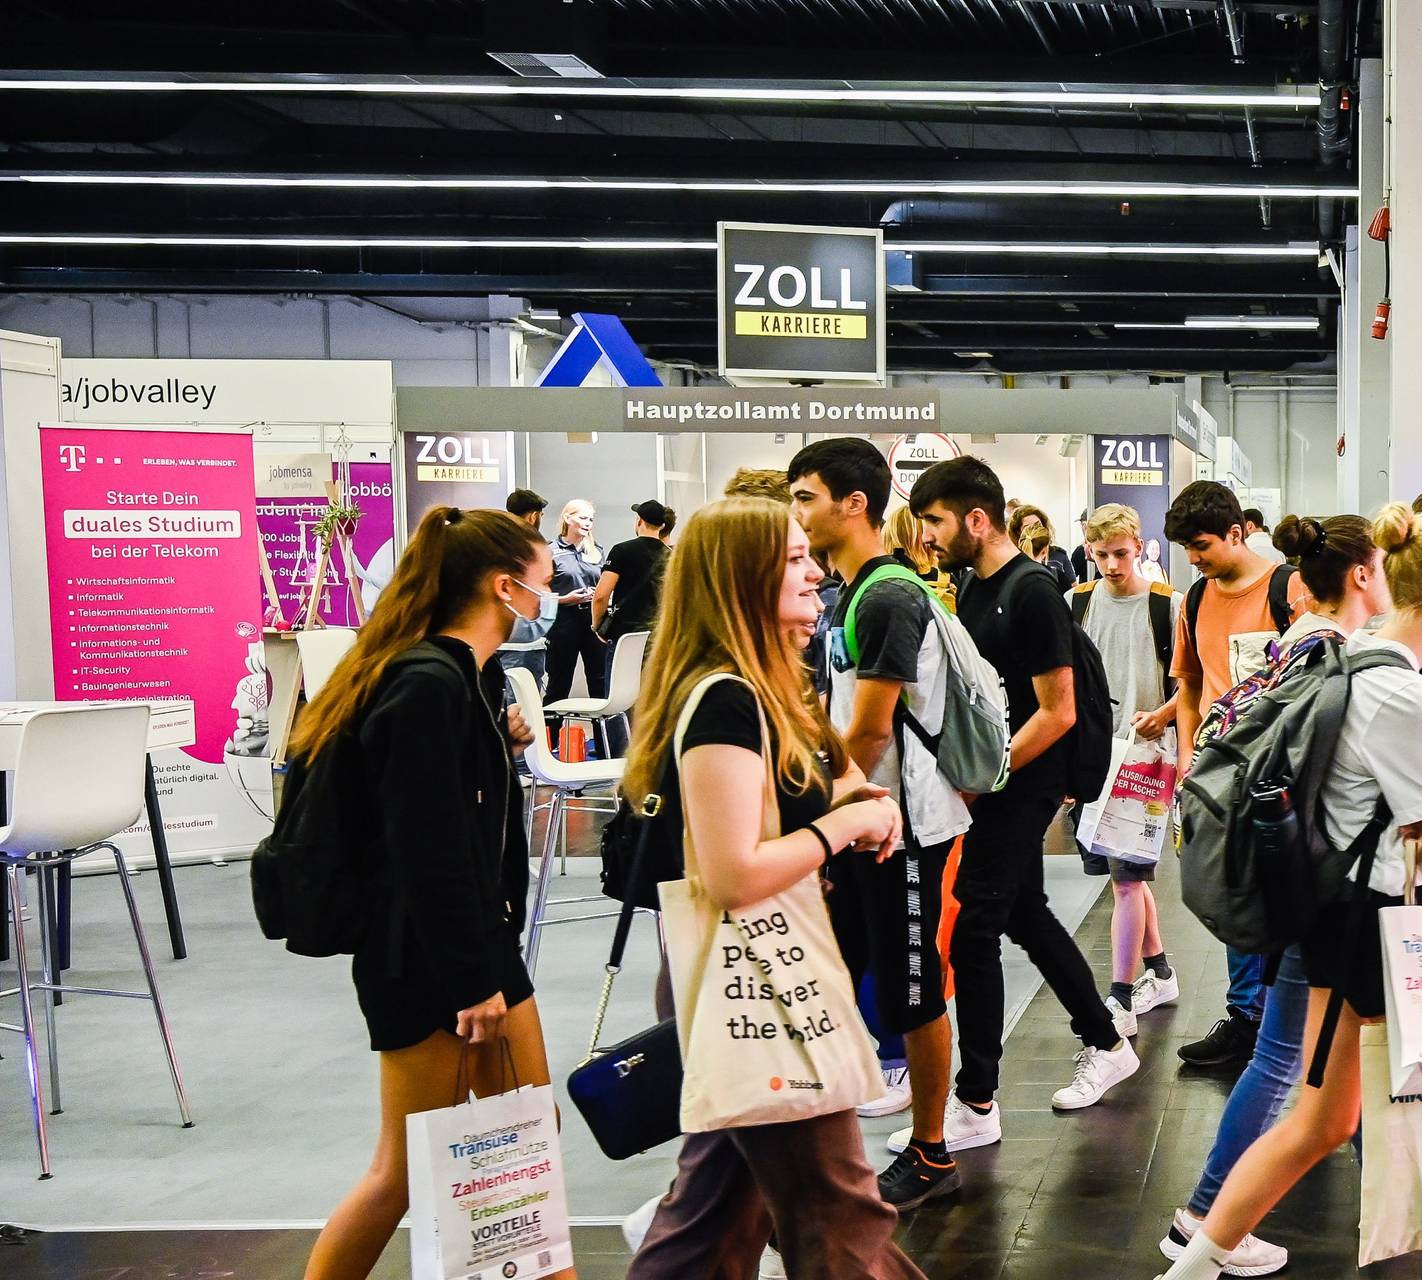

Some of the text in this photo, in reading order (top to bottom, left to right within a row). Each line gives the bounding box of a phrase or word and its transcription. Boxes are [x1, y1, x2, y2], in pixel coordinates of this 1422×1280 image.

[734, 263, 867, 310] ZOLL
[761, 315, 842, 335] KARRIERE
[626, 400, 936, 422] Hauptzollamt Dortmund
[416, 435, 500, 464] ZOLL
[910, 448, 939, 459] ZOLL
[1101, 439, 1163, 468] ZOLL
[143, 458, 178, 467] ERLEBEN,
[197, 459, 238, 467] VERBINDET.
[269, 465, 312, 482] jobmensa
[434, 468, 484, 480] KARRIERE
[1114, 472, 1151, 483] KARRIERE
[107, 491, 199, 505] Starte Dein
[72, 516, 234, 532] duales Studium
[91, 544, 219, 558] bei der Telekom
[76, 576, 175, 586] Wirtschaftsinformatik
[76, 592, 124, 601] Informatik
[78, 605, 215, 617] Telekommunikationsinformatik
[78, 622, 169, 632] Informationstechnik
[79, 637, 160, 648] Informations- und
[80, 648, 188, 660] Kommunikationstechnik
[81, 666, 131, 676] IT-Security
[82, 680, 170, 691] Bauingenieurwesen
[166, 764, 191, 773] echte
[189, 773, 219, 783] digital.
[1119, 769, 1165, 789] AUSBILDUNG
[906, 856, 920, 884] NIKE
[908, 890, 921, 916] NIKE
[909, 922, 921, 947] NIKE
[776, 946, 804, 966] to
[909, 952, 921, 977] NIKE
[909, 982, 921, 1006] NIKE
[727, 1015, 777, 1039] the
[449, 1132, 518, 1159] Transuse
[451, 1159, 552, 1199] Zahlenhengst
[471, 1210, 541, 1242] VORTEILE
